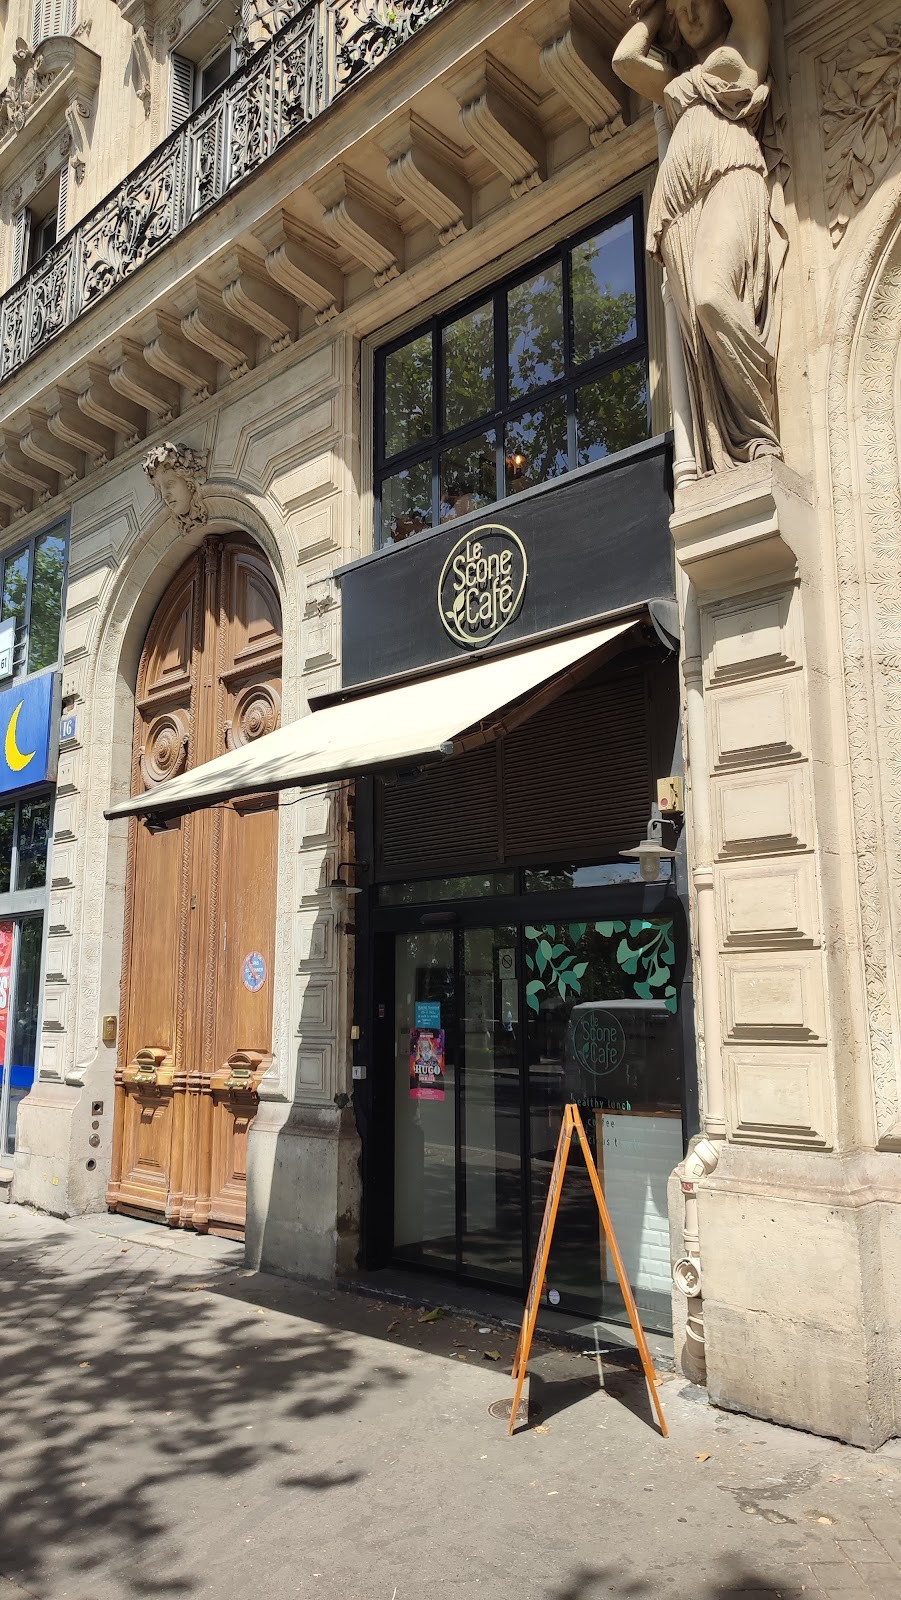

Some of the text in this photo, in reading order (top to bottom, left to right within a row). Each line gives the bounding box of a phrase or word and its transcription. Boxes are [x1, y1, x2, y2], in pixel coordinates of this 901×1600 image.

[453, 550, 512, 591] Scone
[467, 577, 513, 628] Café
[62, 720, 72, 737] 16
[582, 1020, 617, 1042] Scone
[415, 1064, 440, 1075] HUGO
[607, 1100, 631, 1111] lunch
